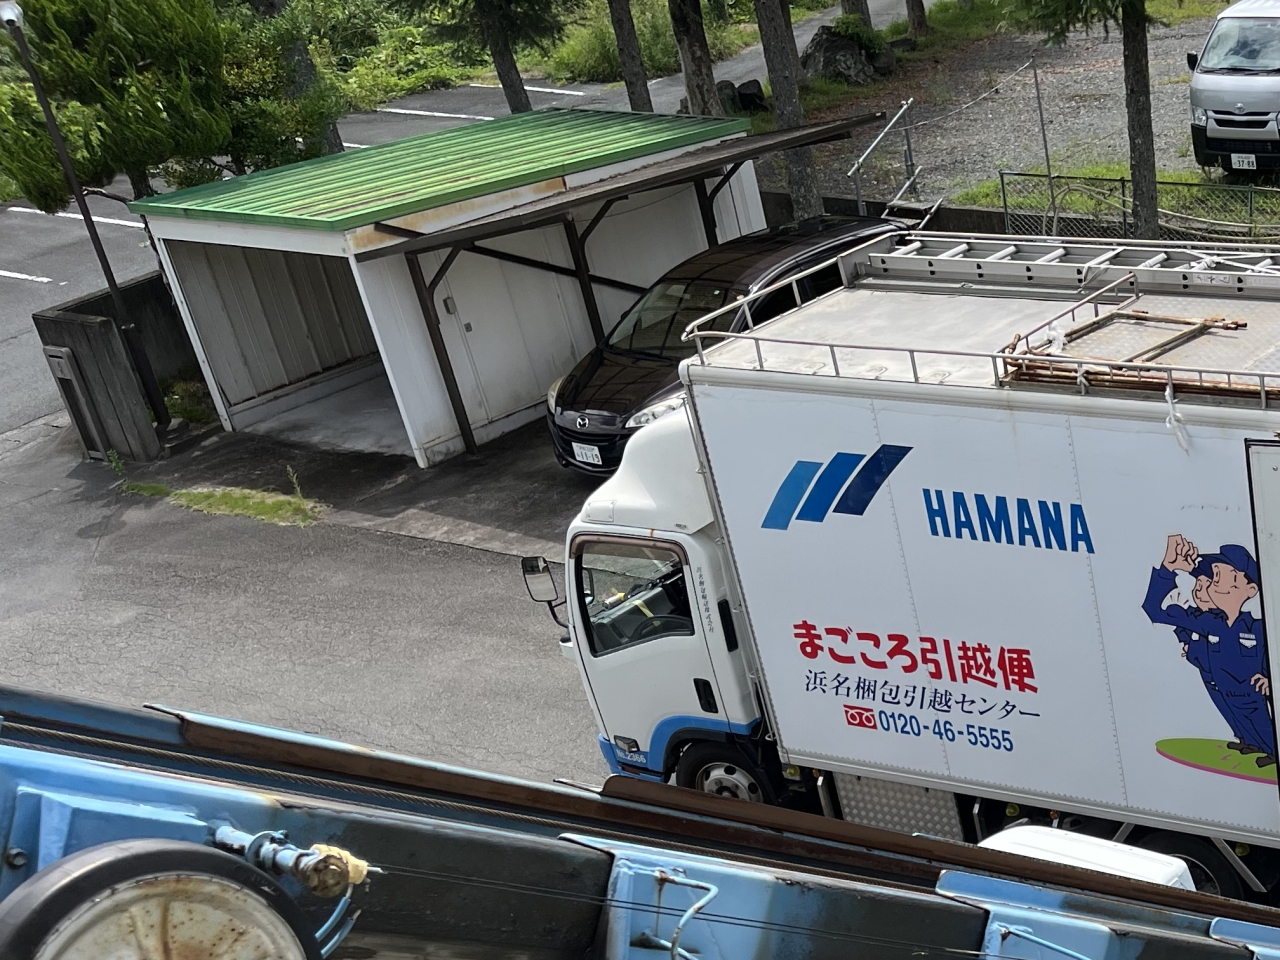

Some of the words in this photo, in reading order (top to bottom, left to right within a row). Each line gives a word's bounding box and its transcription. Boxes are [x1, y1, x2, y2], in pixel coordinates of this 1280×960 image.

[922, 487, 1096, 554] HAMANA
[793, 619, 1038, 694] まごころ引越便
[805, 669, 1041, 720] 浜名梱包引越センター
[878, 709, 1014, 752] 0120-46-5555
